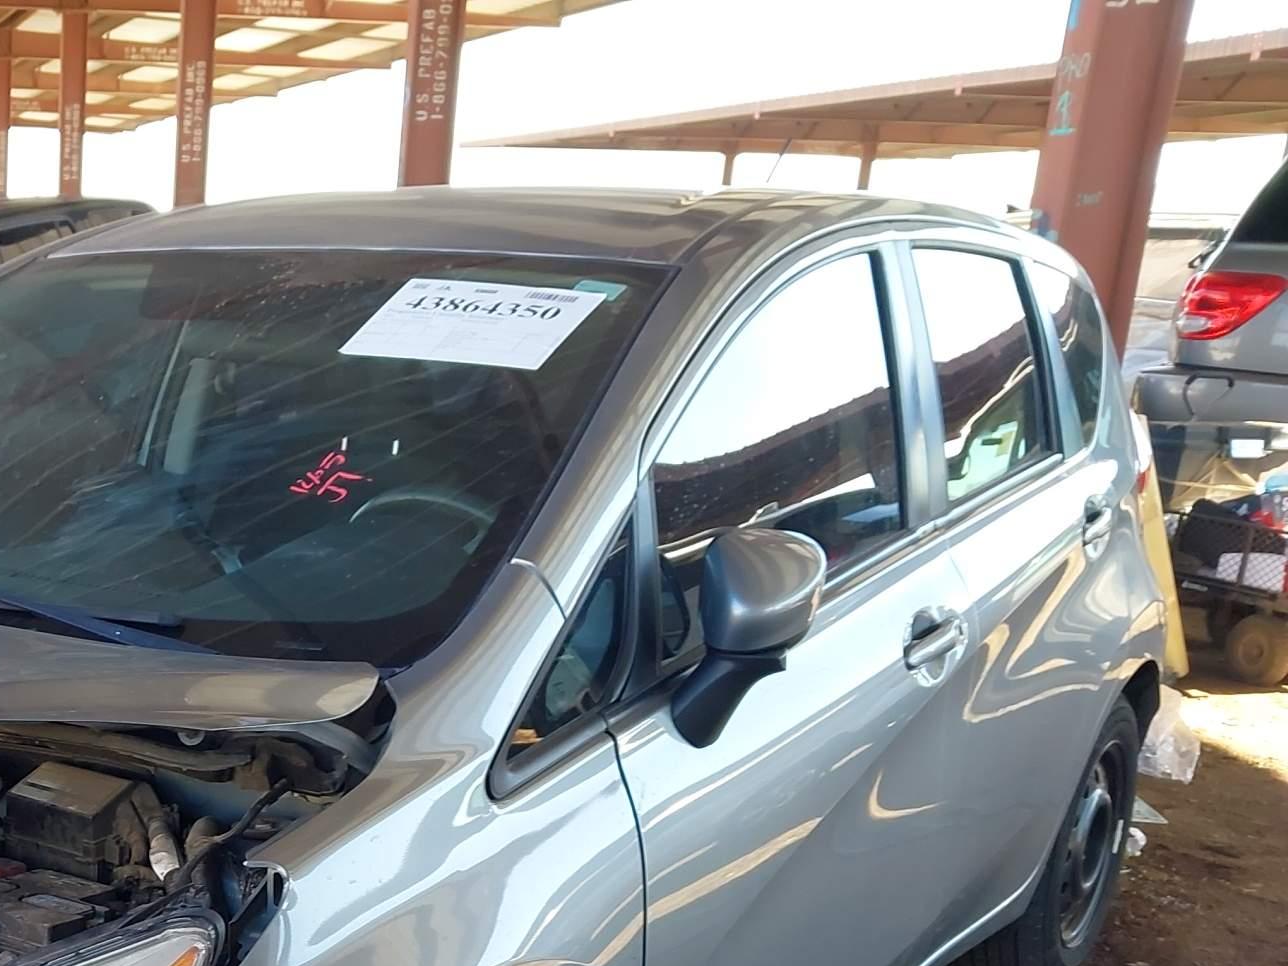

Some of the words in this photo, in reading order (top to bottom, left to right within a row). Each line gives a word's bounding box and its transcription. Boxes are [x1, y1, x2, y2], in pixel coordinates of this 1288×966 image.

[418, 8, 436, 78] PREFAB
[430, 0, 453, 119] 1-866-799-0
[405, 295, 561, 320] 43864350
